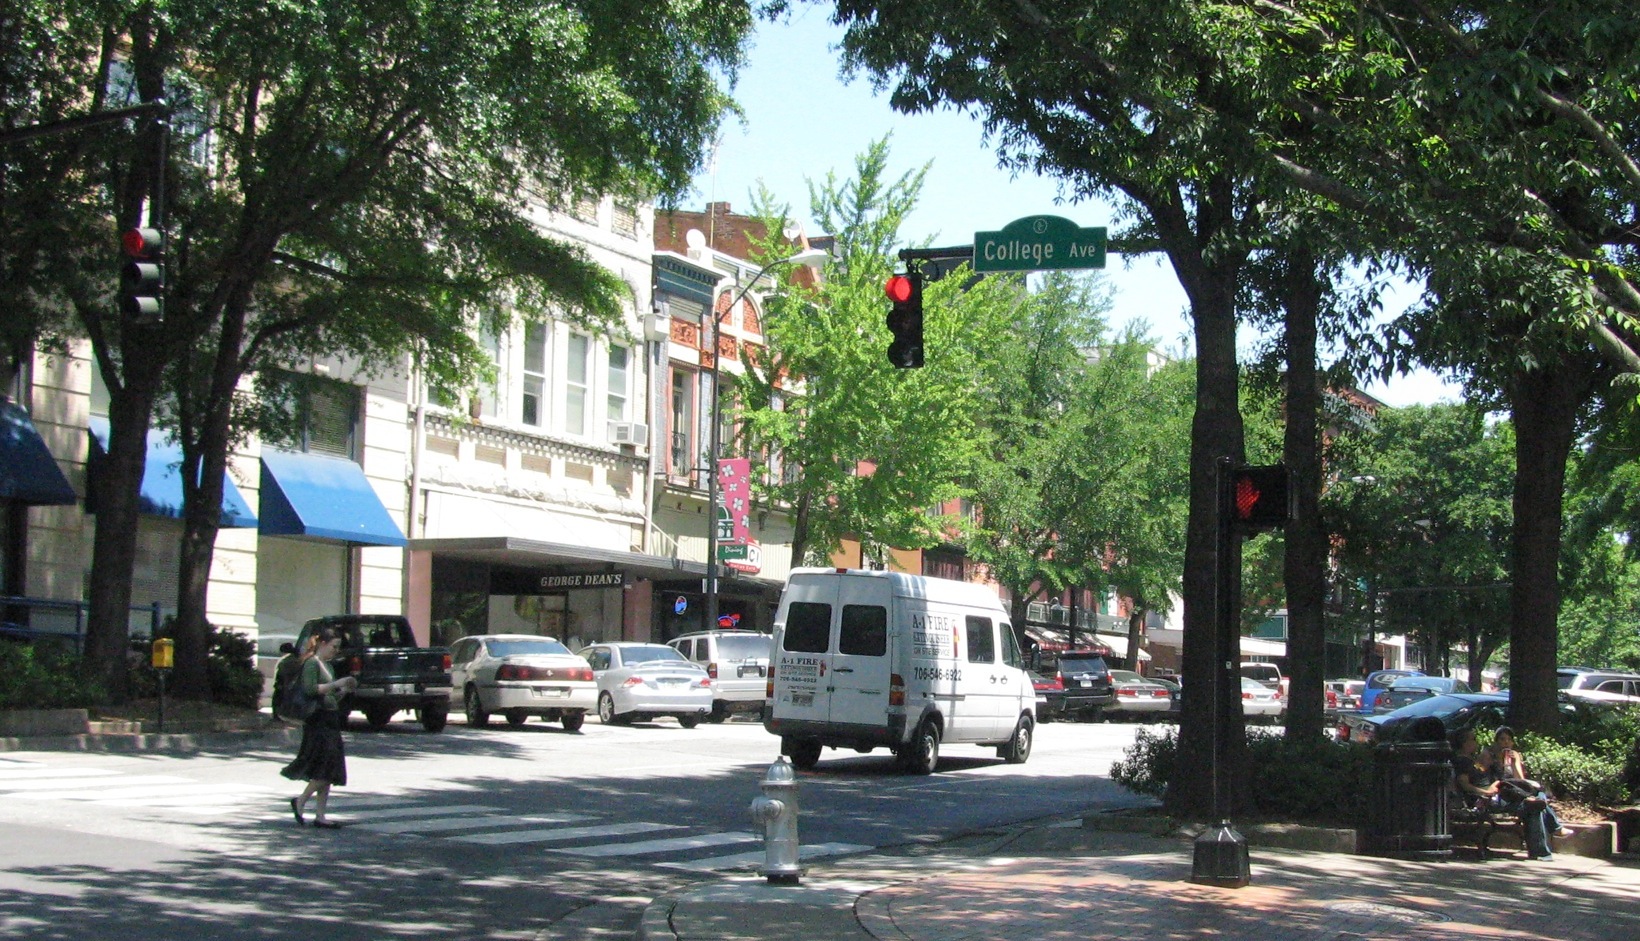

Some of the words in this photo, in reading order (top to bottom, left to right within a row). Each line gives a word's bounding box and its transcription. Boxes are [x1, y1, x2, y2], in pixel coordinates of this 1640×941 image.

[984, 240, 1054, 265] College
[1069, 242, 1096, 258] Ave
[724, 545, 744, 555] Dining
[540, 575, 582, 587] GEORGE
[584, 573, 623, 585] DEAN'S
[912, 614, 926, 630] A-1
[928, 615, 950, 631] FIRE
[797, 657, 819, 666] FIRE
[914, 666, 962, 682] 706-546-6922
